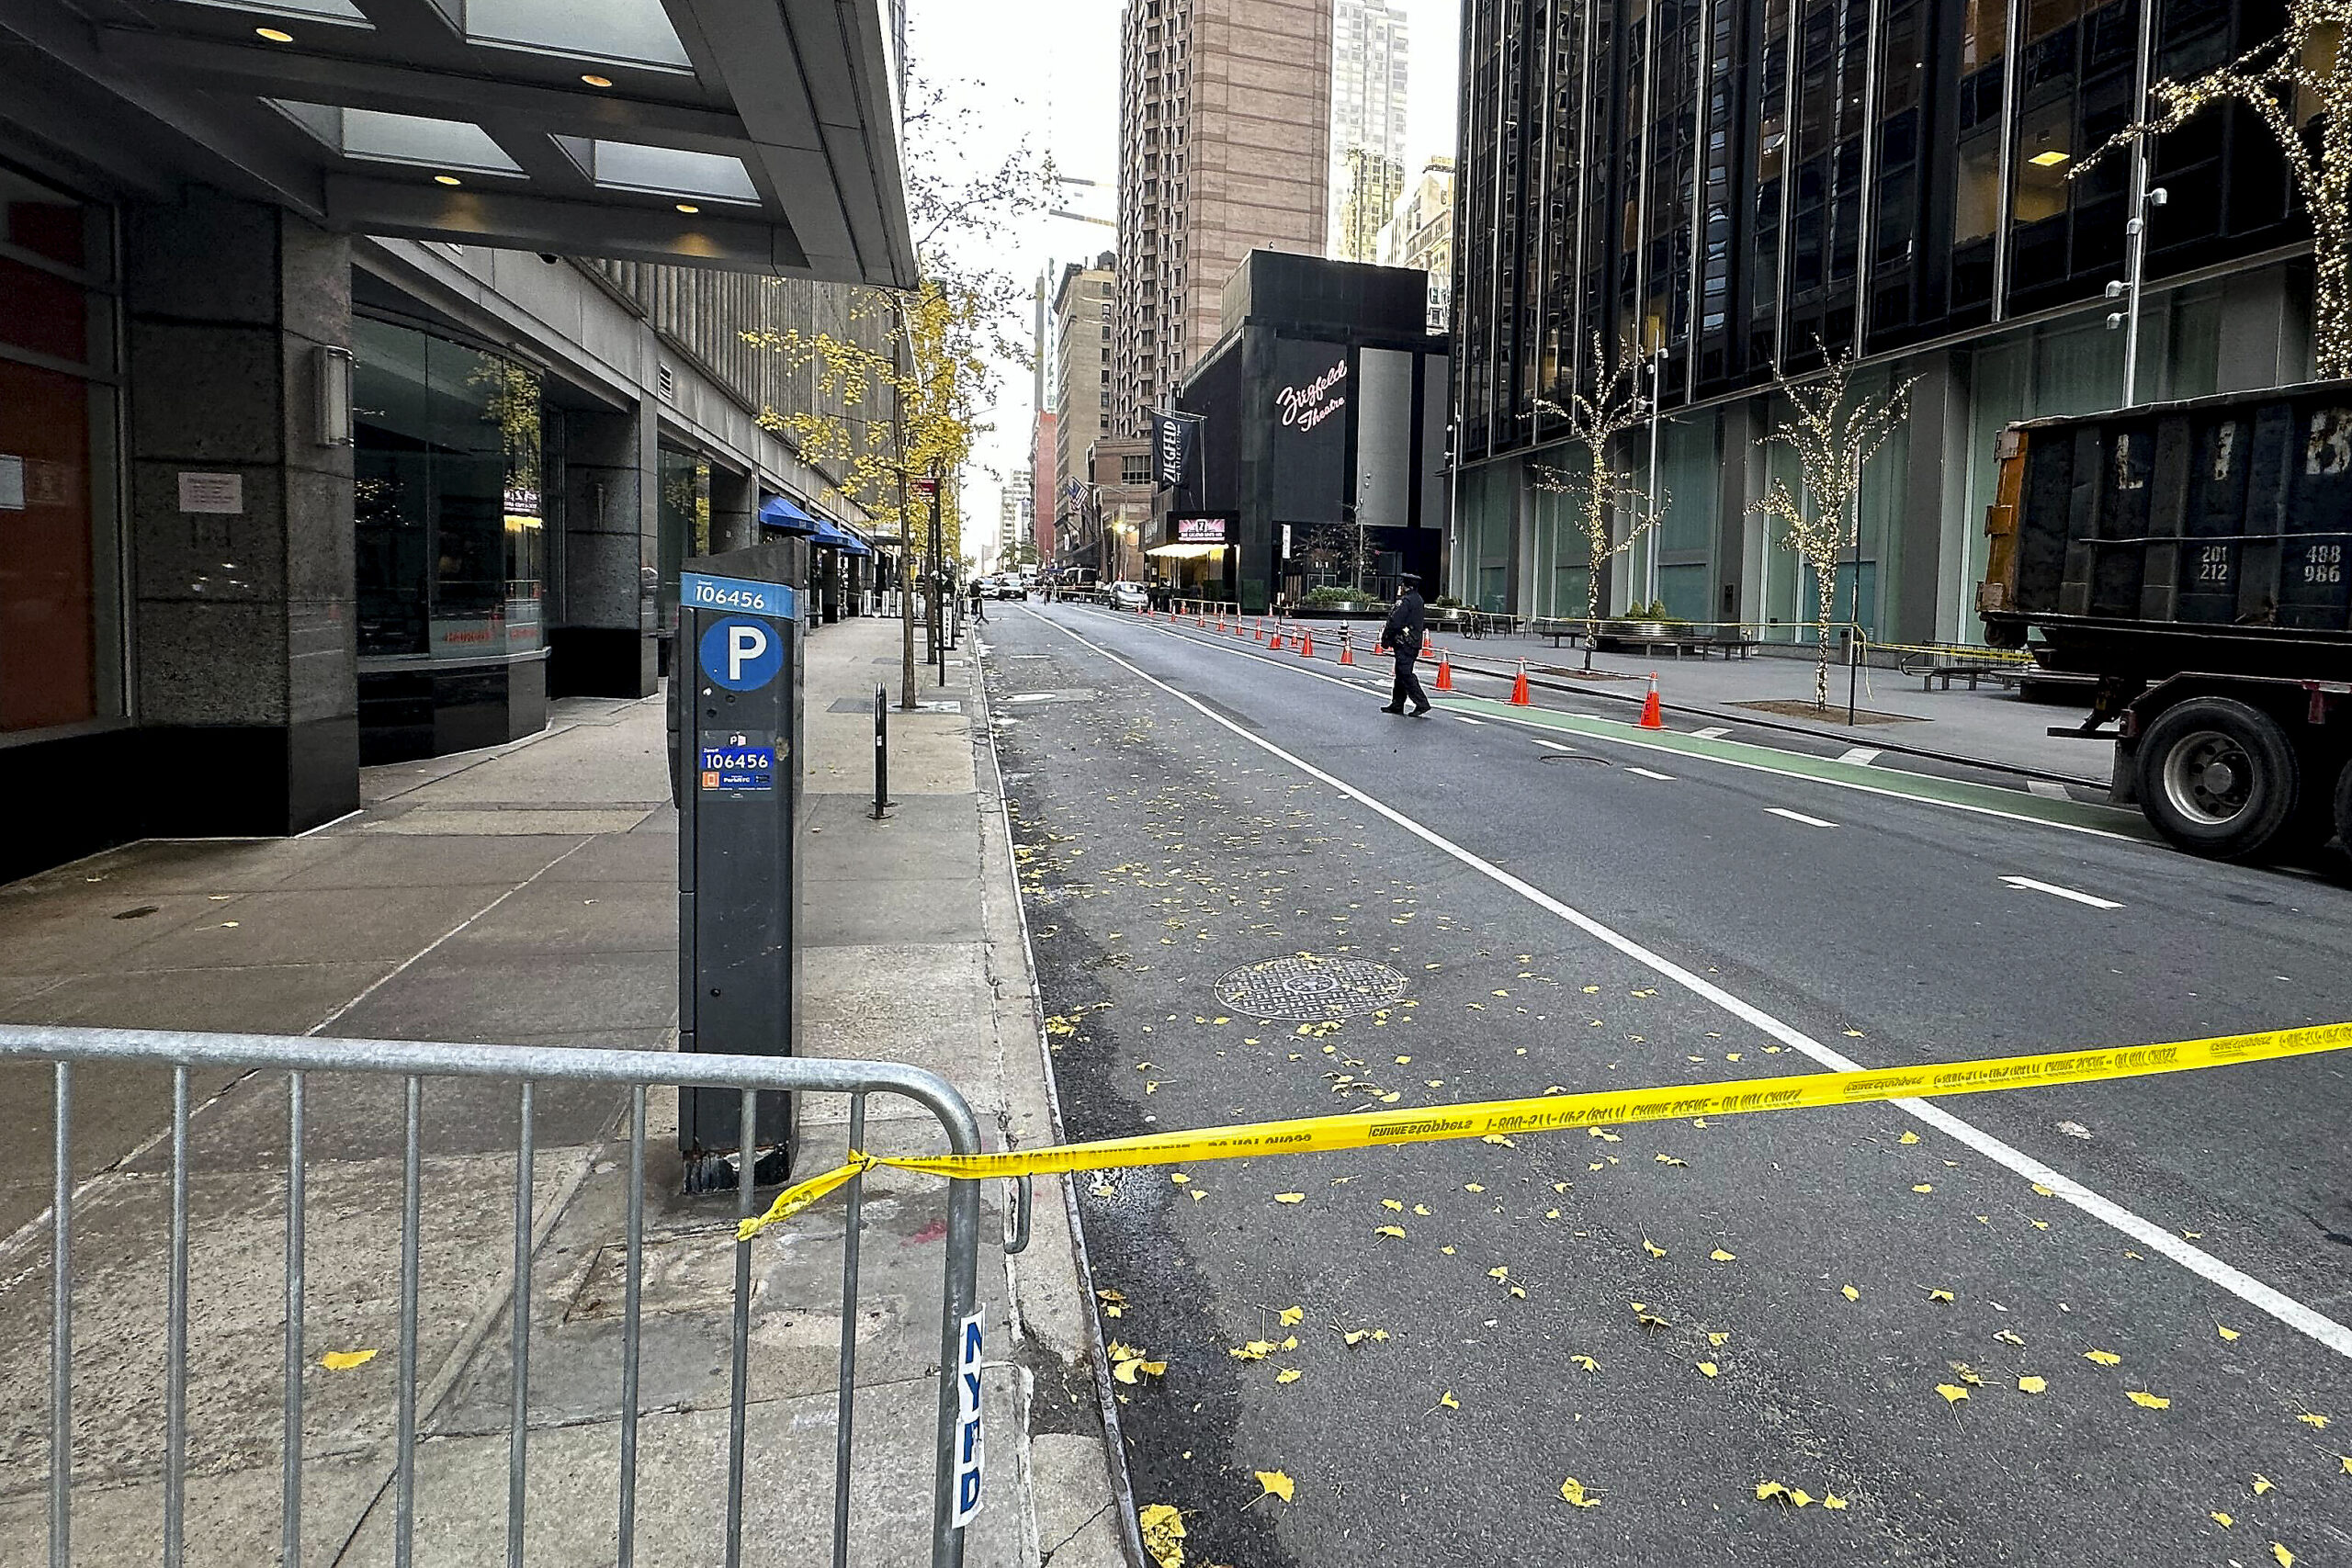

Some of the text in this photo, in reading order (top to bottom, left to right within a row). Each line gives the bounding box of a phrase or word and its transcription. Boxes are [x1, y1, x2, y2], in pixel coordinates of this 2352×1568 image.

[1275, 359, 1347, 425] Ziegfeld
[1297, 397, 1345, 432] Theatre
[1163, 421, 1176, 482] ZIEGFELD
[2201, 545, 2341, 563] 201 488
[2200, 564, 2341, 582] 212 986
[696, 585, 764, 610] 106456
[729, 626, 767, 681] P
[707, 754, 768, 769] 106456
